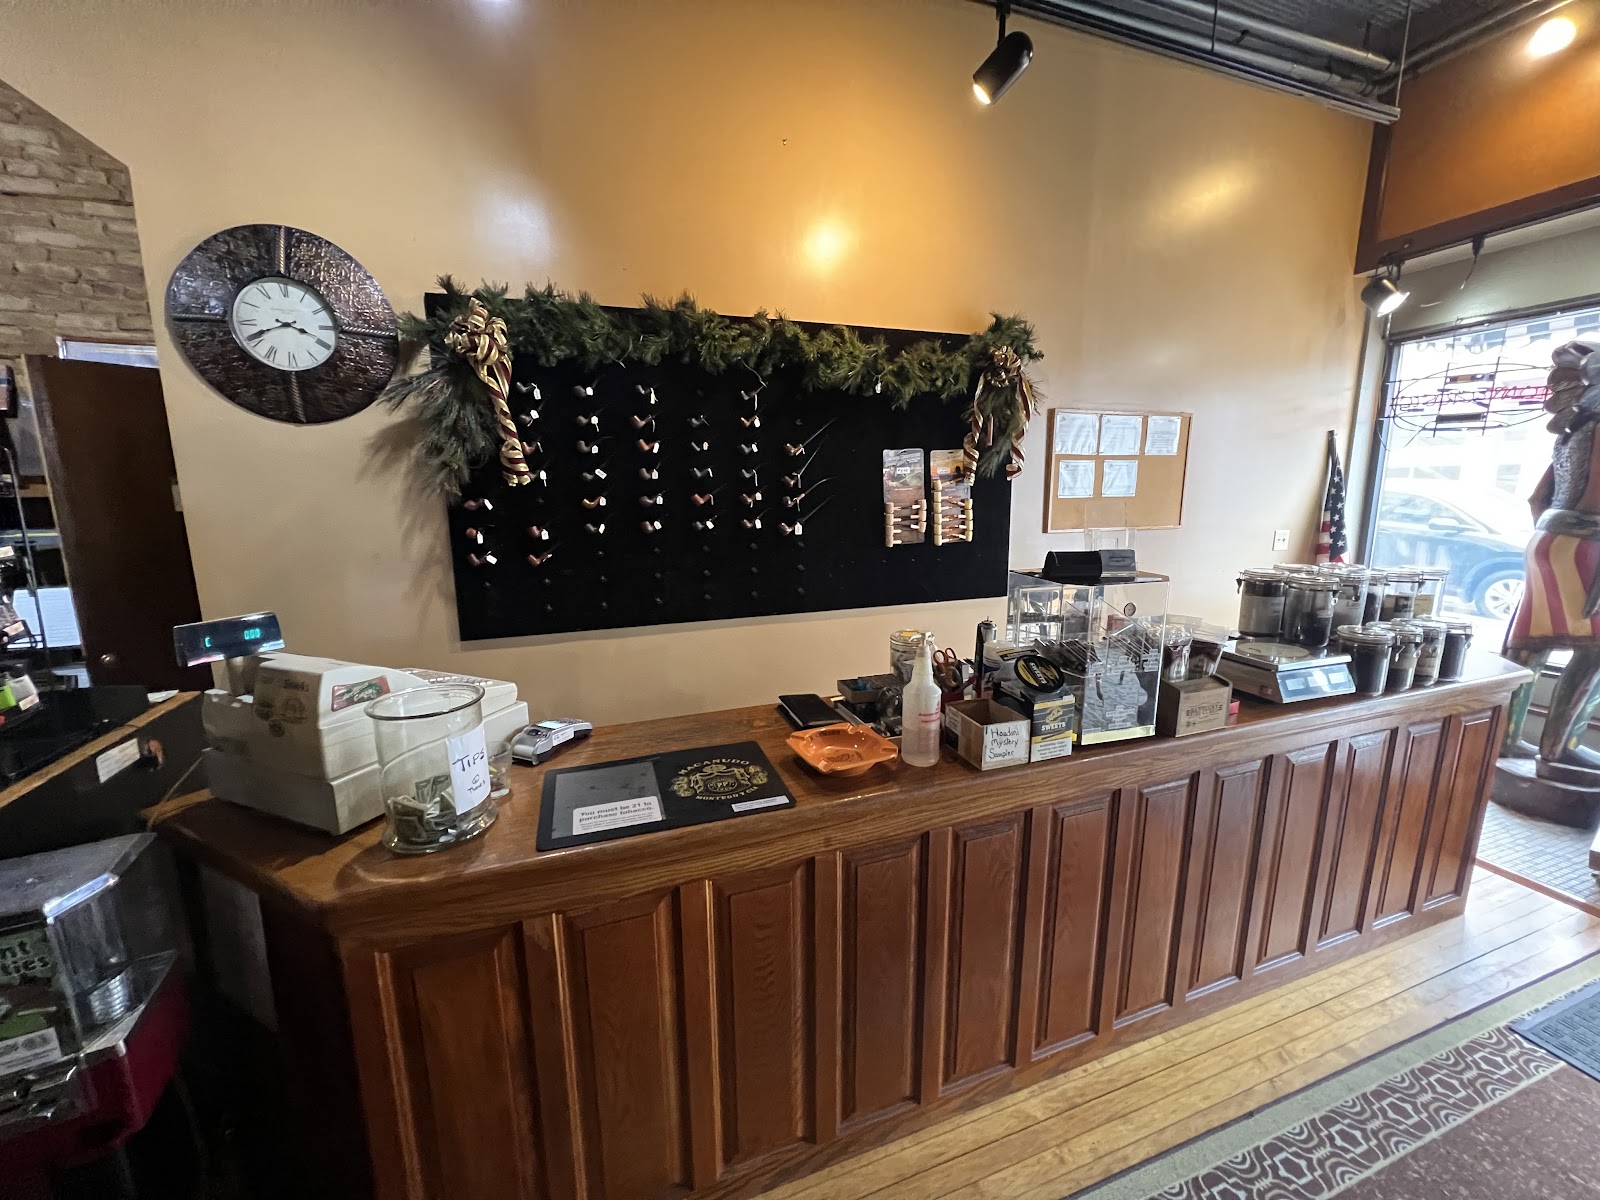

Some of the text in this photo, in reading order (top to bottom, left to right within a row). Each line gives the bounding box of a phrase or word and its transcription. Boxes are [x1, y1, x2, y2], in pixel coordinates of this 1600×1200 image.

[1029, 662, 1048, 684] SWEETS
[1041, 721, 1066, 731] SWEETS
[991, 727, 1019, 738] Houdini
[678, 758, 750, 775] MACANUDO
[597, 806, 618, 814] must
[579, 811, 618, 822] purchase
